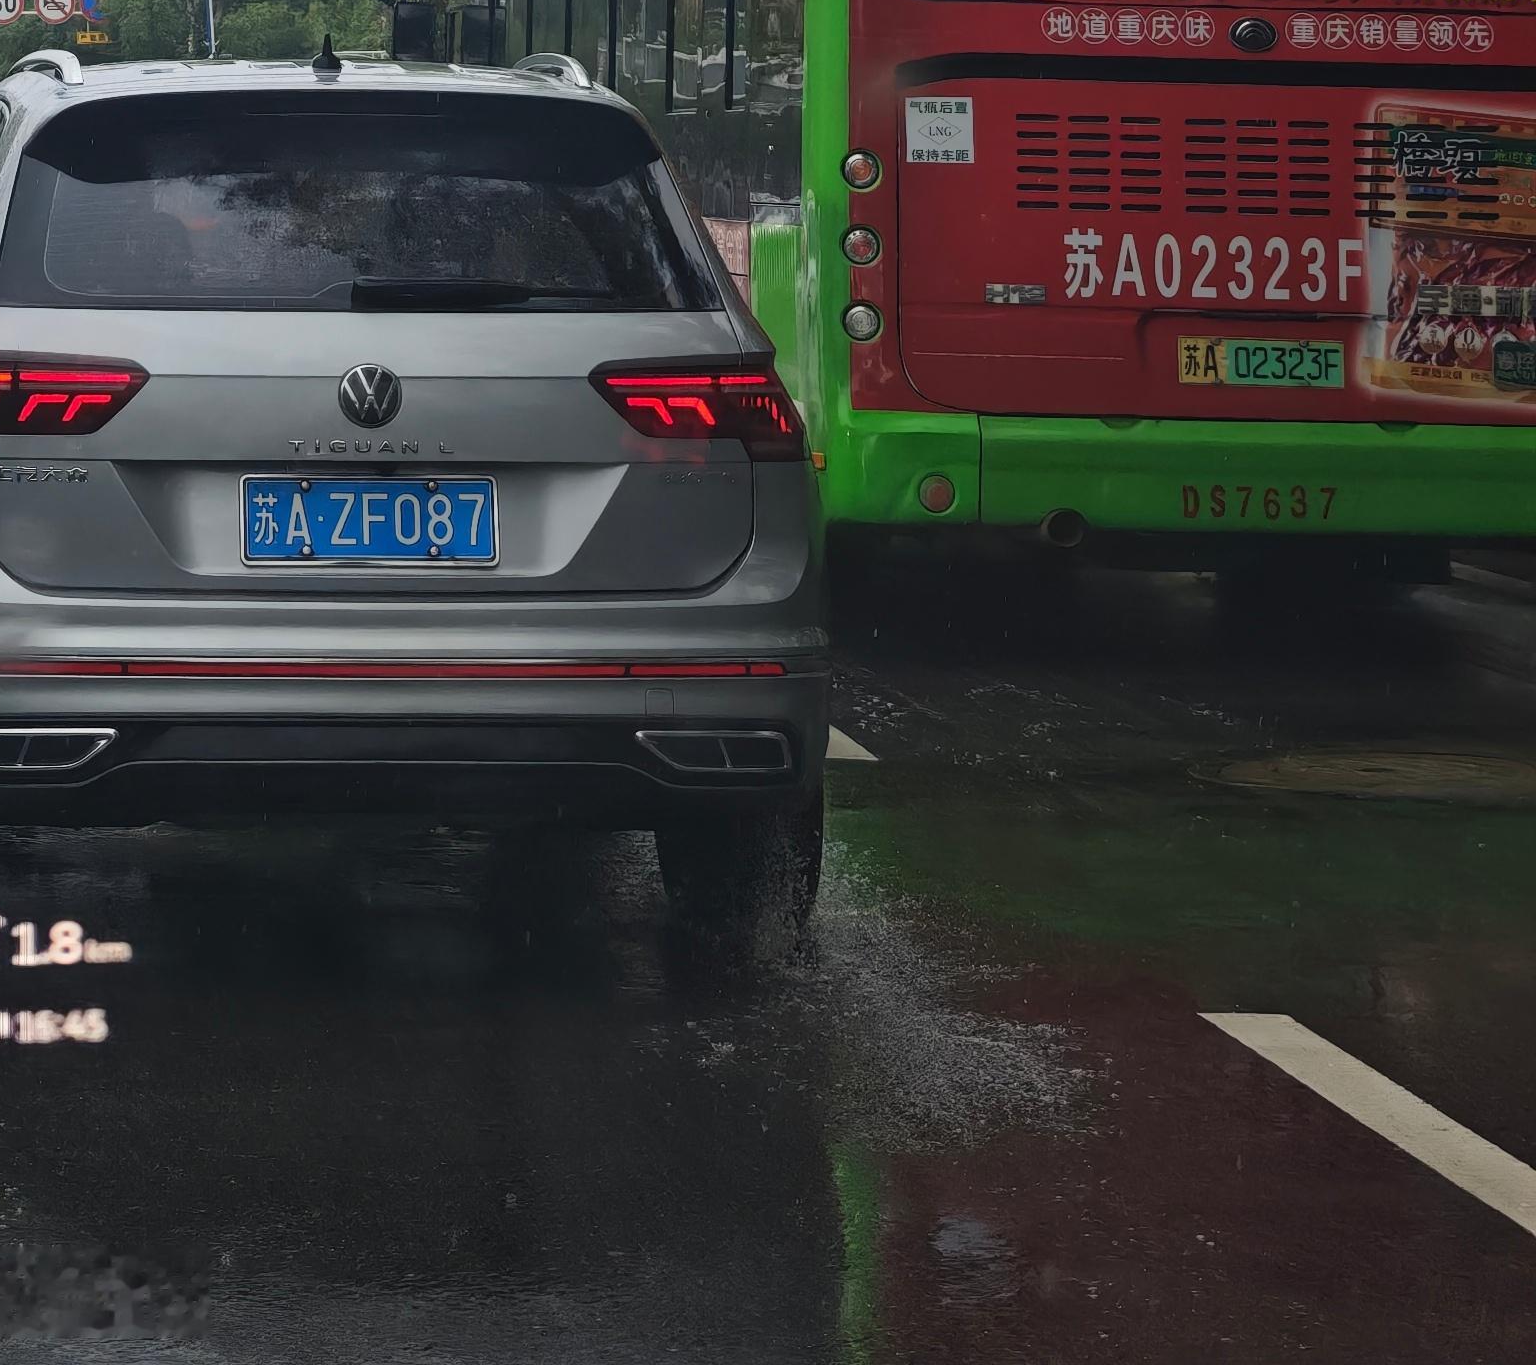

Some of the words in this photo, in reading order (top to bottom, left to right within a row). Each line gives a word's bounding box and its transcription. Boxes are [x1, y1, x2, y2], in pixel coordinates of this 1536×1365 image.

[1046, 10, 1214, 43] 地道重庆味
[1290, 16, 1493, 49] 重庆销量领先
[910, 101, 968, 114] 气瓶后置
[929, 126, 952, 137] LNG
[912, 149, 970, 162] 保持车距
[1064, 228, 1362, 302] 苏A02323F
[288, 438, 419, 454] TIGUAN
[439, 440, 455, 454] L
[1182, 484, 1339, 520] DS7637
